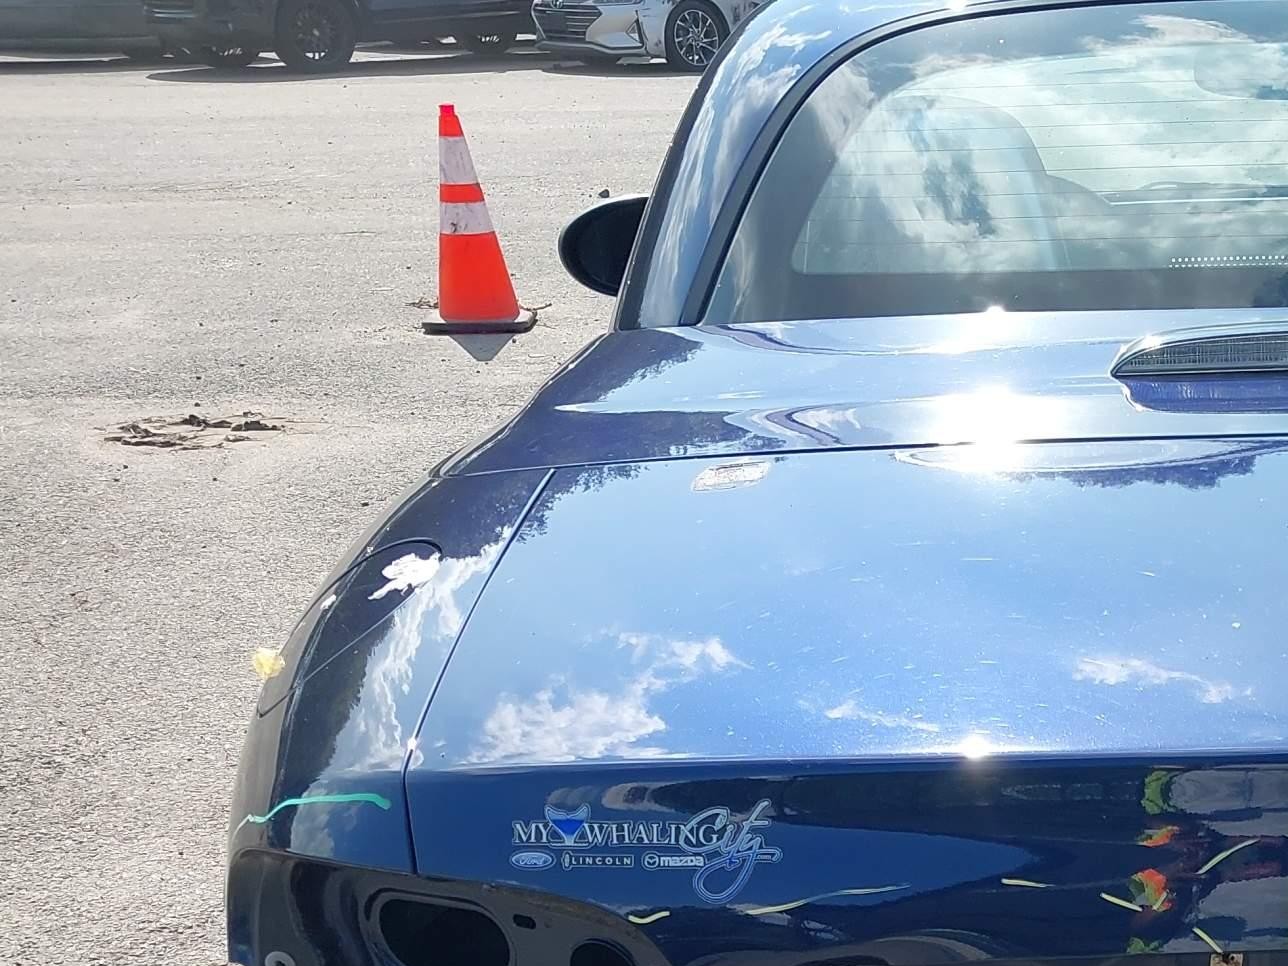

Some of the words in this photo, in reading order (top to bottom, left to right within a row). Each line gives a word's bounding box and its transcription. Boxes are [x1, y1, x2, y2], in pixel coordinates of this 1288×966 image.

[514, 822, 552, 843] MY
[584, 822, 719, 845] WHALING
[680, 800, 780, 900] City
[571, 856, 632, 866] LINCOLN
[659, 855, 705, 867] mazda
